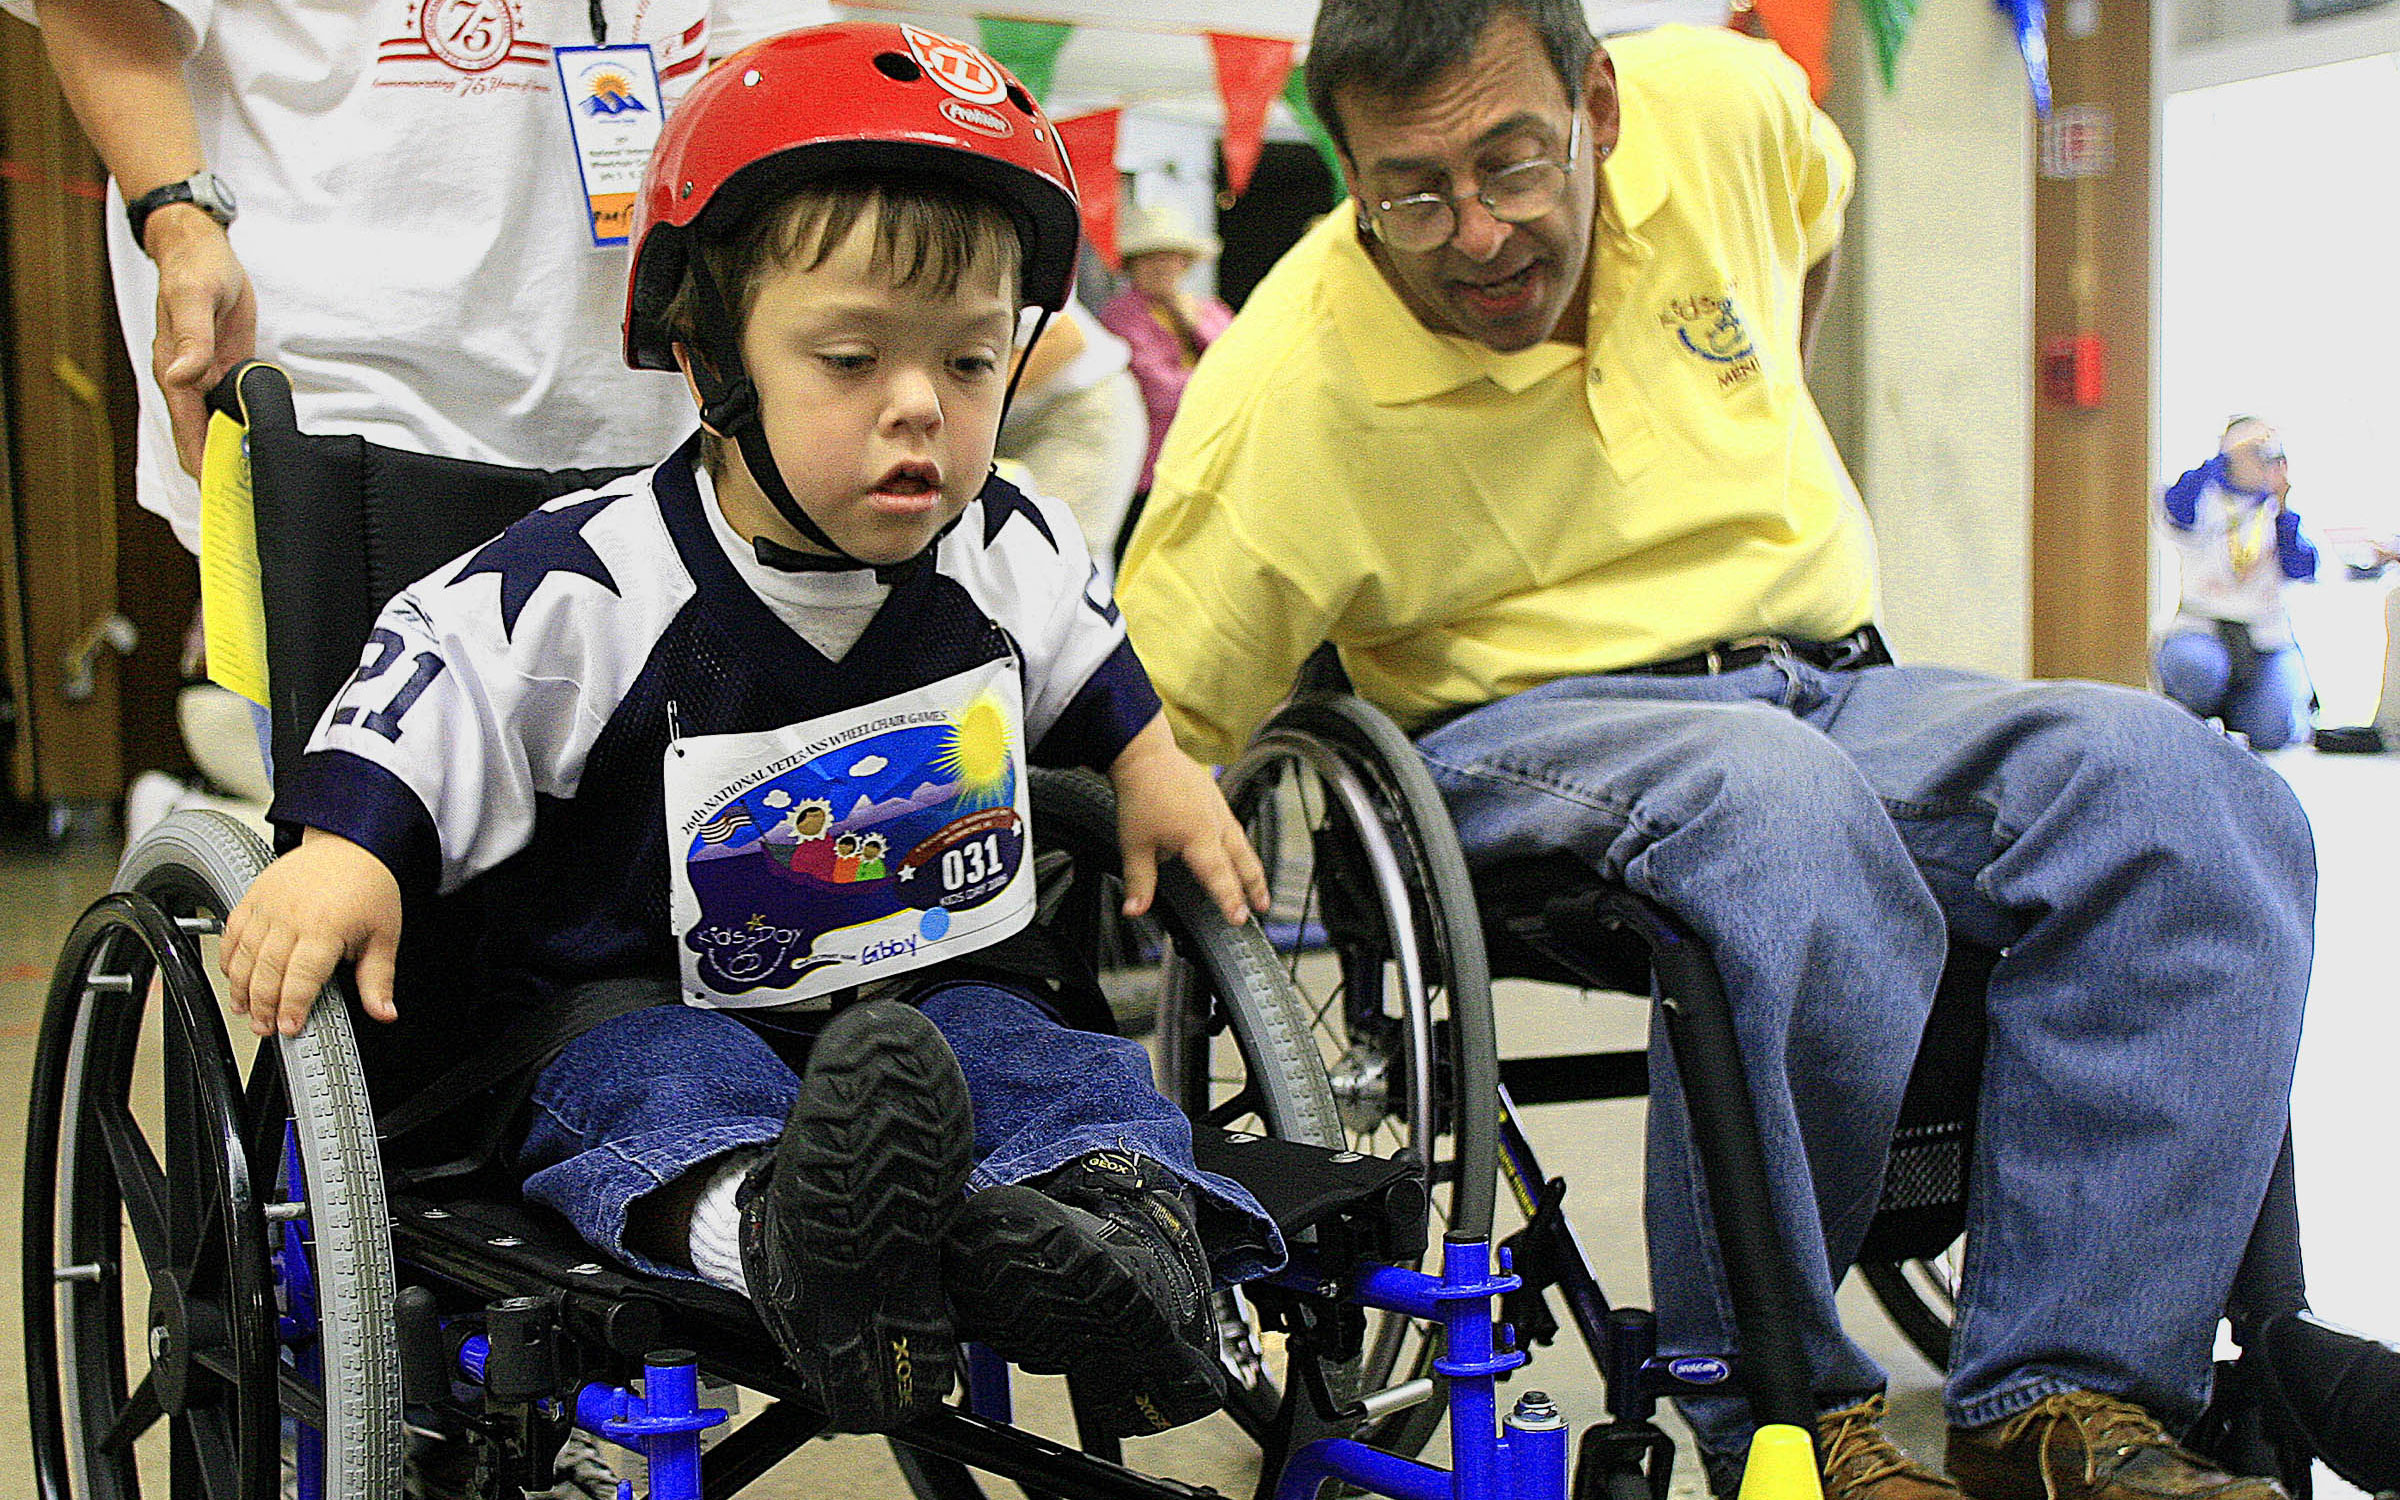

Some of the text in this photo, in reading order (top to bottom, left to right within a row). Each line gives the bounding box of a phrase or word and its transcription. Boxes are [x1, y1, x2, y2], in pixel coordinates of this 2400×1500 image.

[449, 0, 497, 52] 75
[460, 76, 486, 98] 75
[330, 626, 446, 743] 21
[704, 767, 769, 811] NATIONAL
[767, 738, 827, 775] VETERANS
[829, 713, 906, 746] WHEELCHAIR
[907, 709, 948, 724] GAMES
[941, 834, 1004, 891] 031
[861, 933, 919, 965] Gibby
[1089, 1157, 1129, 1175] GEOX
